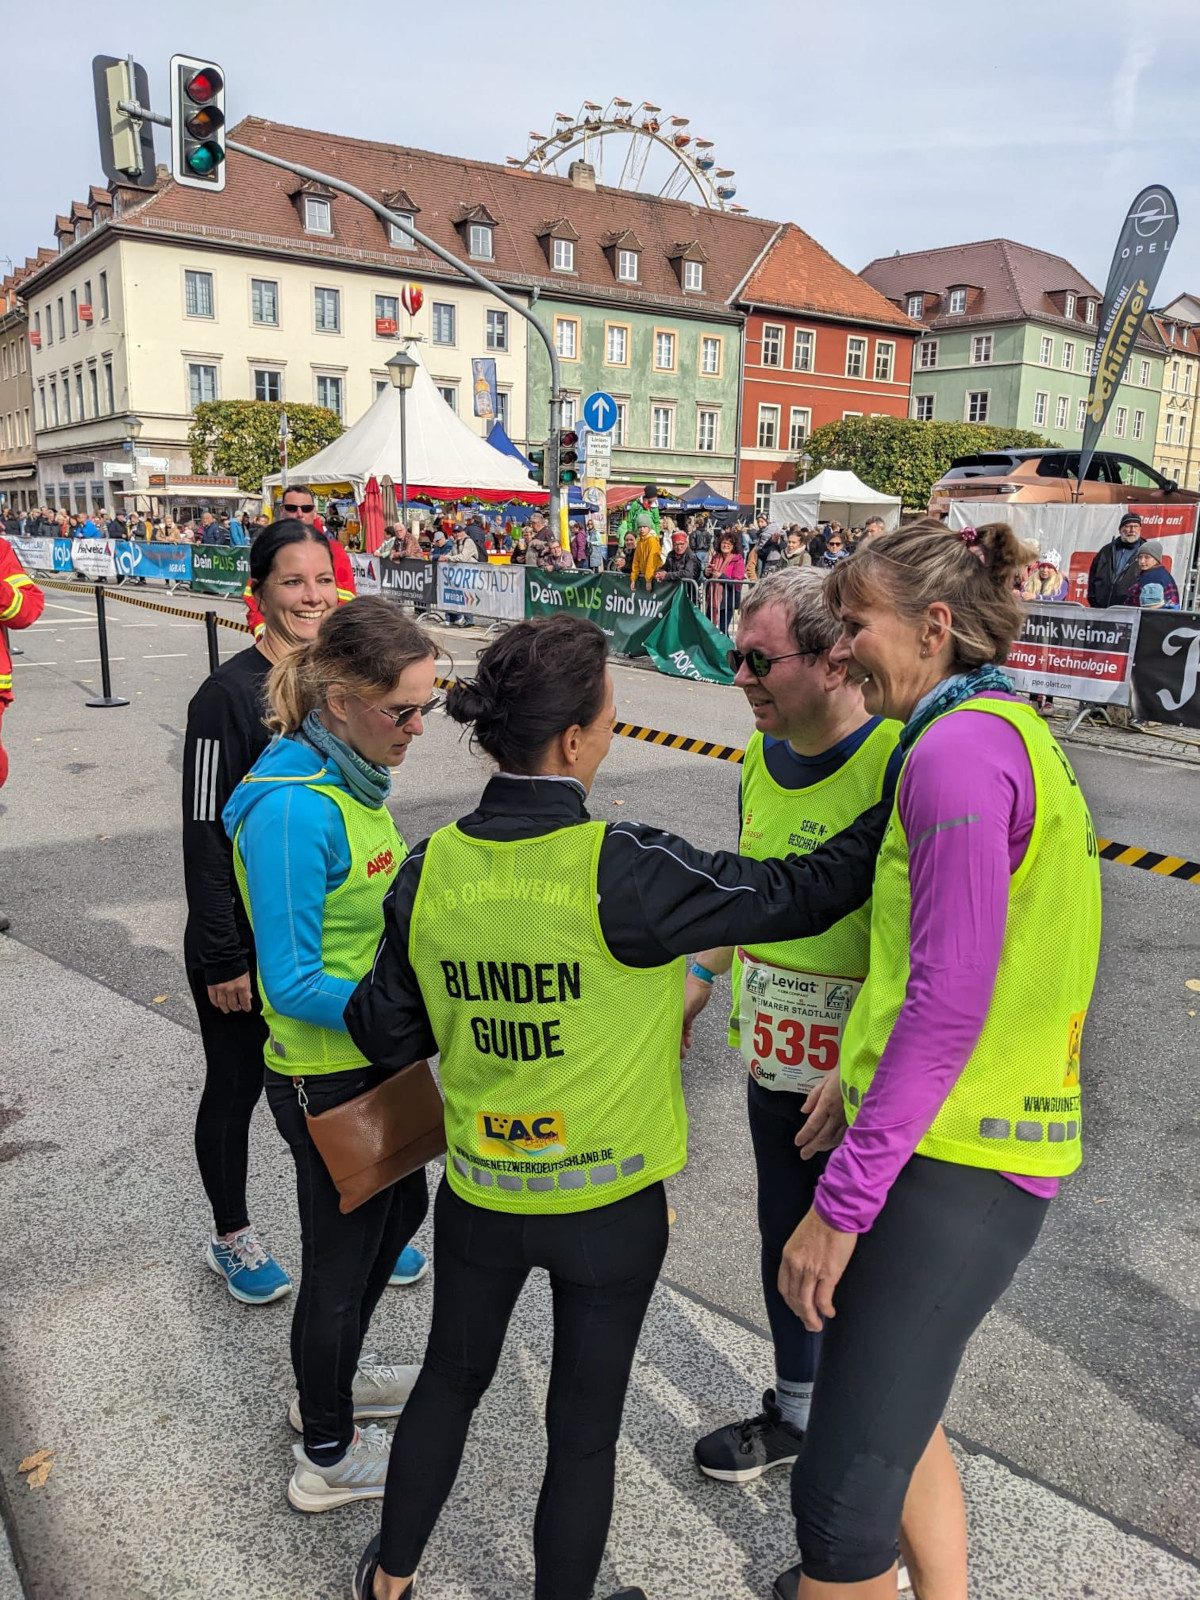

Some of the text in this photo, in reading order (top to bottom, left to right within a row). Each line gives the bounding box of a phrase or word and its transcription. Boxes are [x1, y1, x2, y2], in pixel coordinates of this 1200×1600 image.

[1121, 242, 1170, 259] OPEL
[1091, 285, 1129, 377] SERVICE ERLEBEN!
[1087, 279, 1149, 423] Schinner
[1166, 516, 1183, 525] an!
[193, 554, 212, 569] Dein
[213, 555, 235, 571] PLUS
[236, 557, 251, 571] sin
[382, 568, 424, 591] LINDIG
[442, 566, 517, 593] SPORTSTADT
[529, 581, 663, 619] Dein PLUS sind wir.
[1021, 618, 1124, 645] chnik Weimar
[668, 649, 695, 675] AOK
[1007, 649, 1036, 666] ering
[1048, 653, 1118, 675] Technologie
[440, 960, 581, 1004] BLINDEN
[772, 973, 817, 993] Leviat
[752, 995, 789, 1013] WEIMARER
[791, 1006, 842, 1020] STADTLAUF
[470, 1016, 564, 1062] GUIDE
[753, 1011, 840, 1071] 535
[756, 1064, 776, 1082] Glatt
[483, 1115, 556, 1141] LAC
